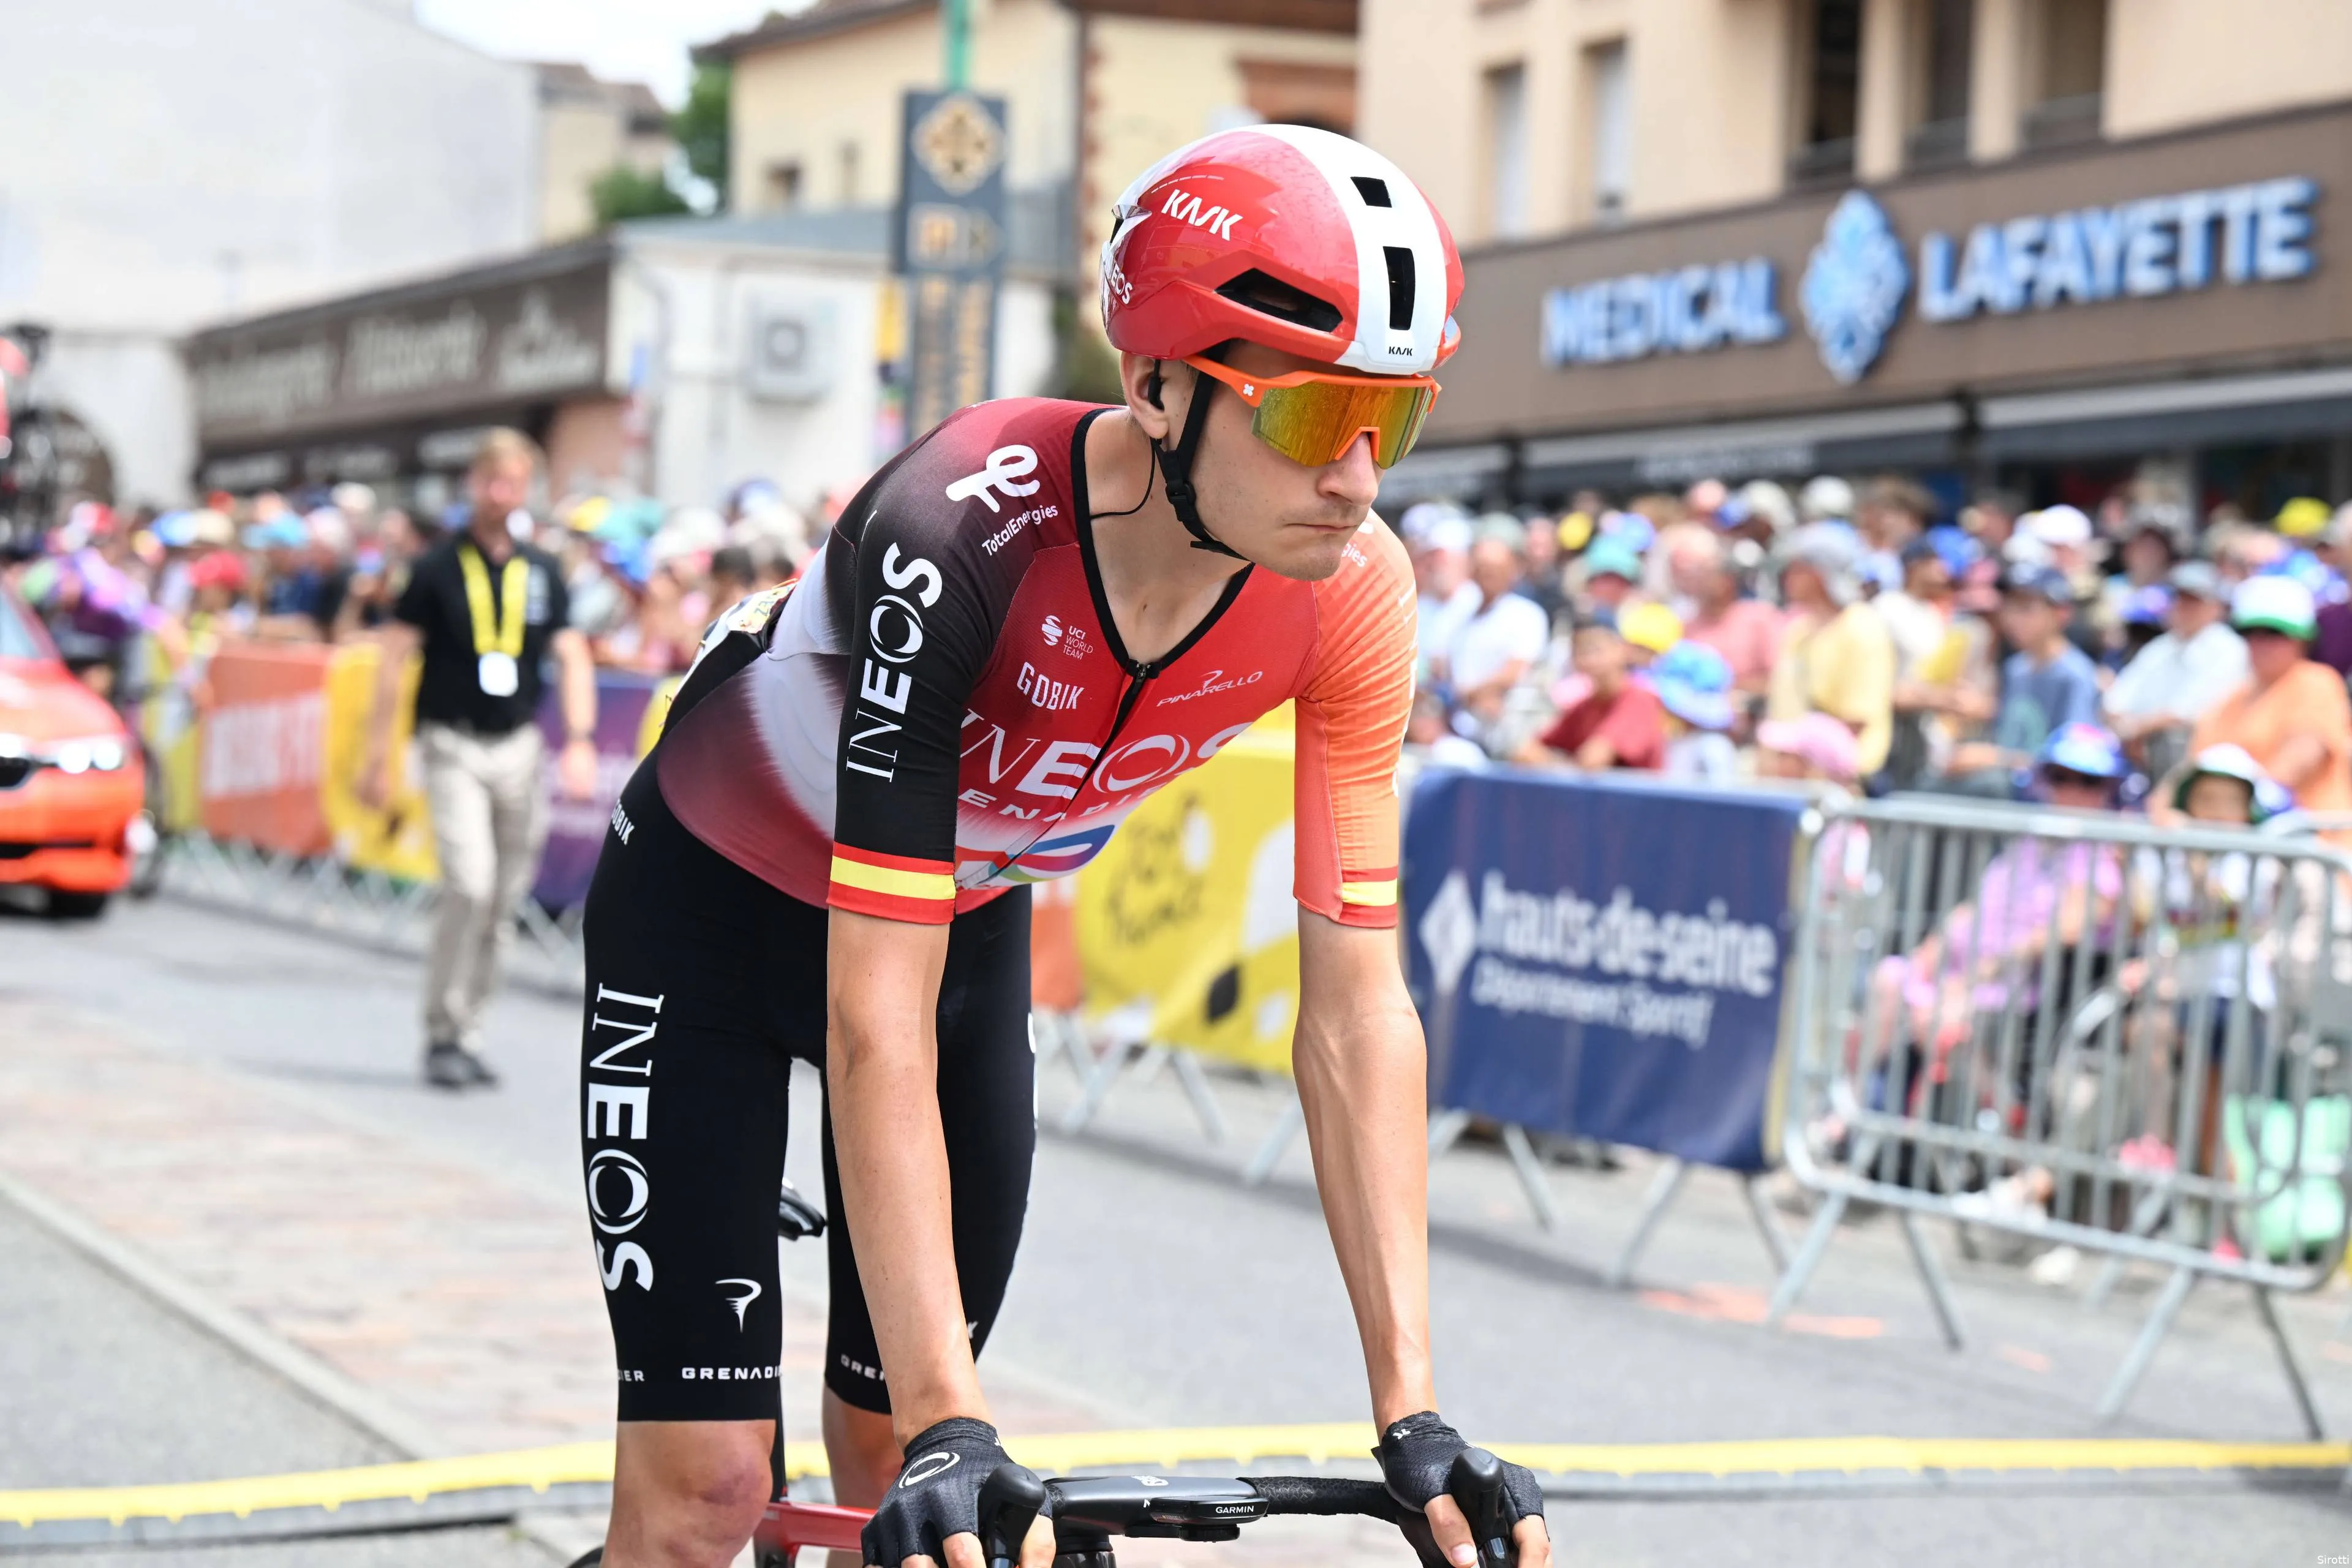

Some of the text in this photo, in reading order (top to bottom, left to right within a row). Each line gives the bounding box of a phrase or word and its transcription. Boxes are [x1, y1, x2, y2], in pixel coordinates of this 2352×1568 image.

[1161, 189, 1243, 241] KASK
[1540, 176, 2319, 369] MEDICAL LAFAYETTE
[1389, 346, 1412, 356] KASK
[981, 505, 1058, 556] TotalEnergies
[1063, 644, 1084, 660] TEAM
[1066, 635, 1093, 654] WORLD
[1069, 625, 1086, 640] UCI
[846, 542, 943, 783] INEOS
[1017, 662, 1085, 710] GOBIK
[1156, 671, 1263, 707] PINARELLO
[587, 982, 665, 1292] INEOS
